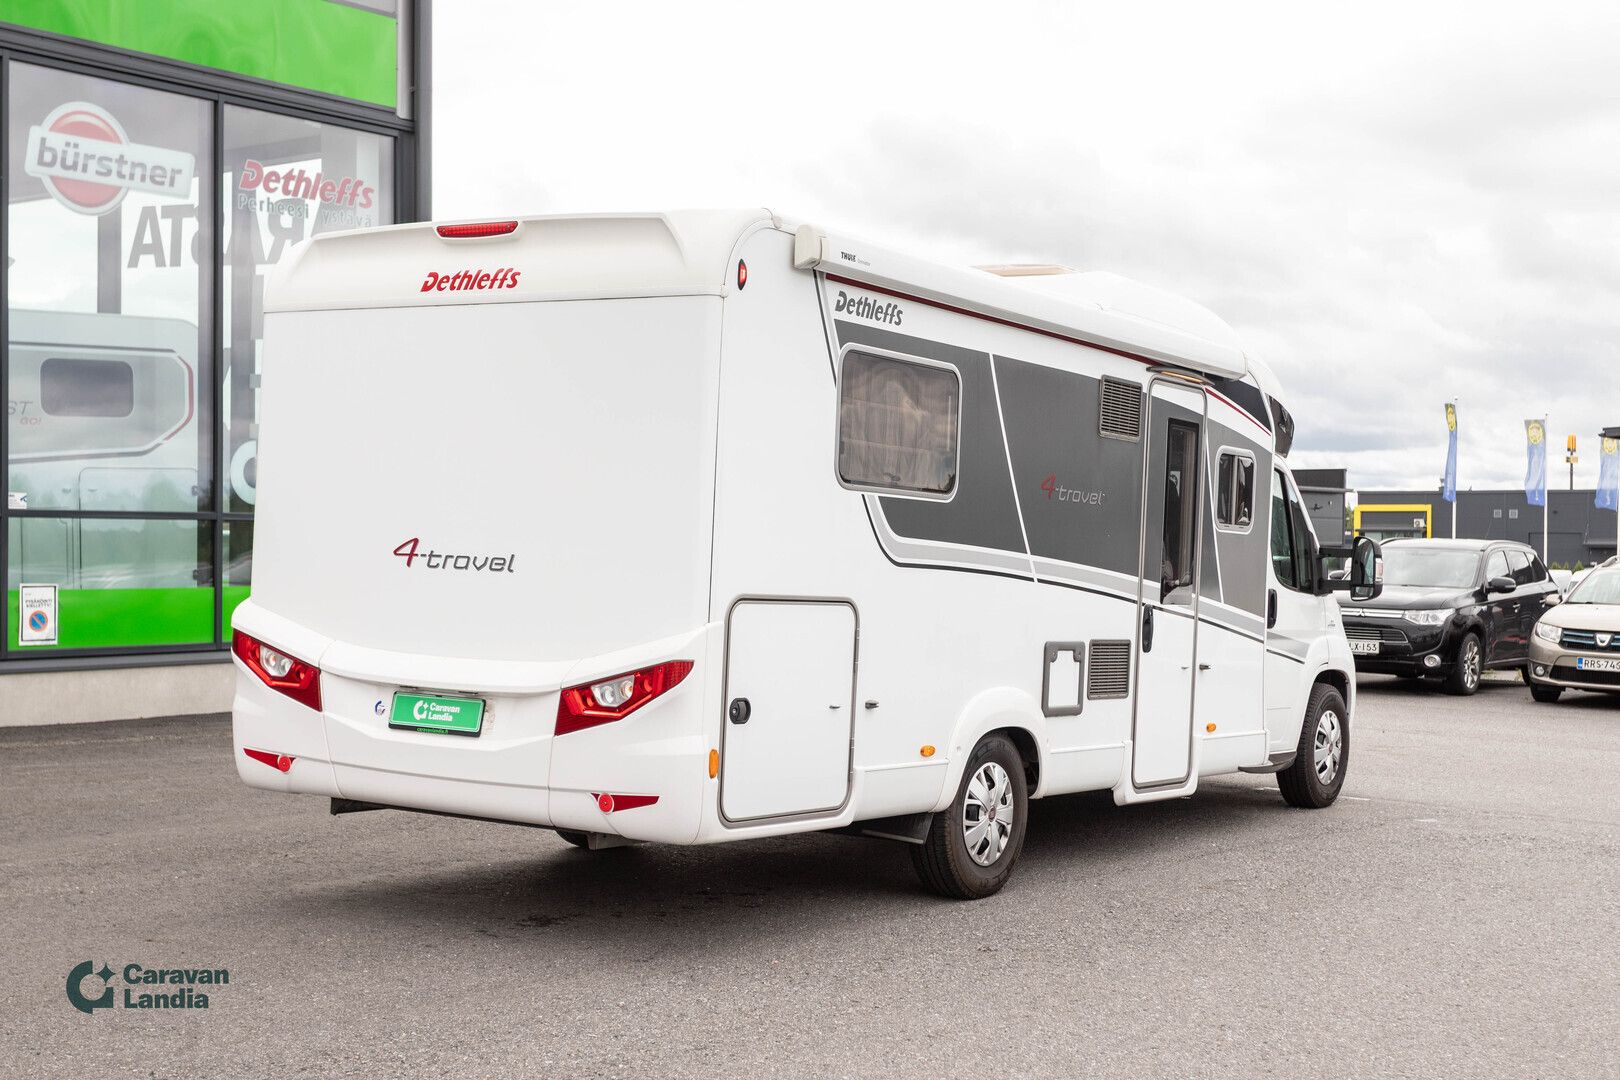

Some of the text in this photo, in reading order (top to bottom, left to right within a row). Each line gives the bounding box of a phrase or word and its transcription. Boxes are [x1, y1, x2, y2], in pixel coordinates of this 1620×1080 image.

[36, 136, 183, 188] bürstner
[239, 158, 375, 209] Dethleffs
[238, 194, 309, 219] Perheesi
[420, 267, 522, 293] Dethleffs
[834, 290, 904, 326] Dethleffs
[1040, 472, 1104, 506] 4-travel
[393, 537, 515, 573] 4-travel
[428, 712, 453, 722] Landia
[429, 702, 461, 714] Caravan
